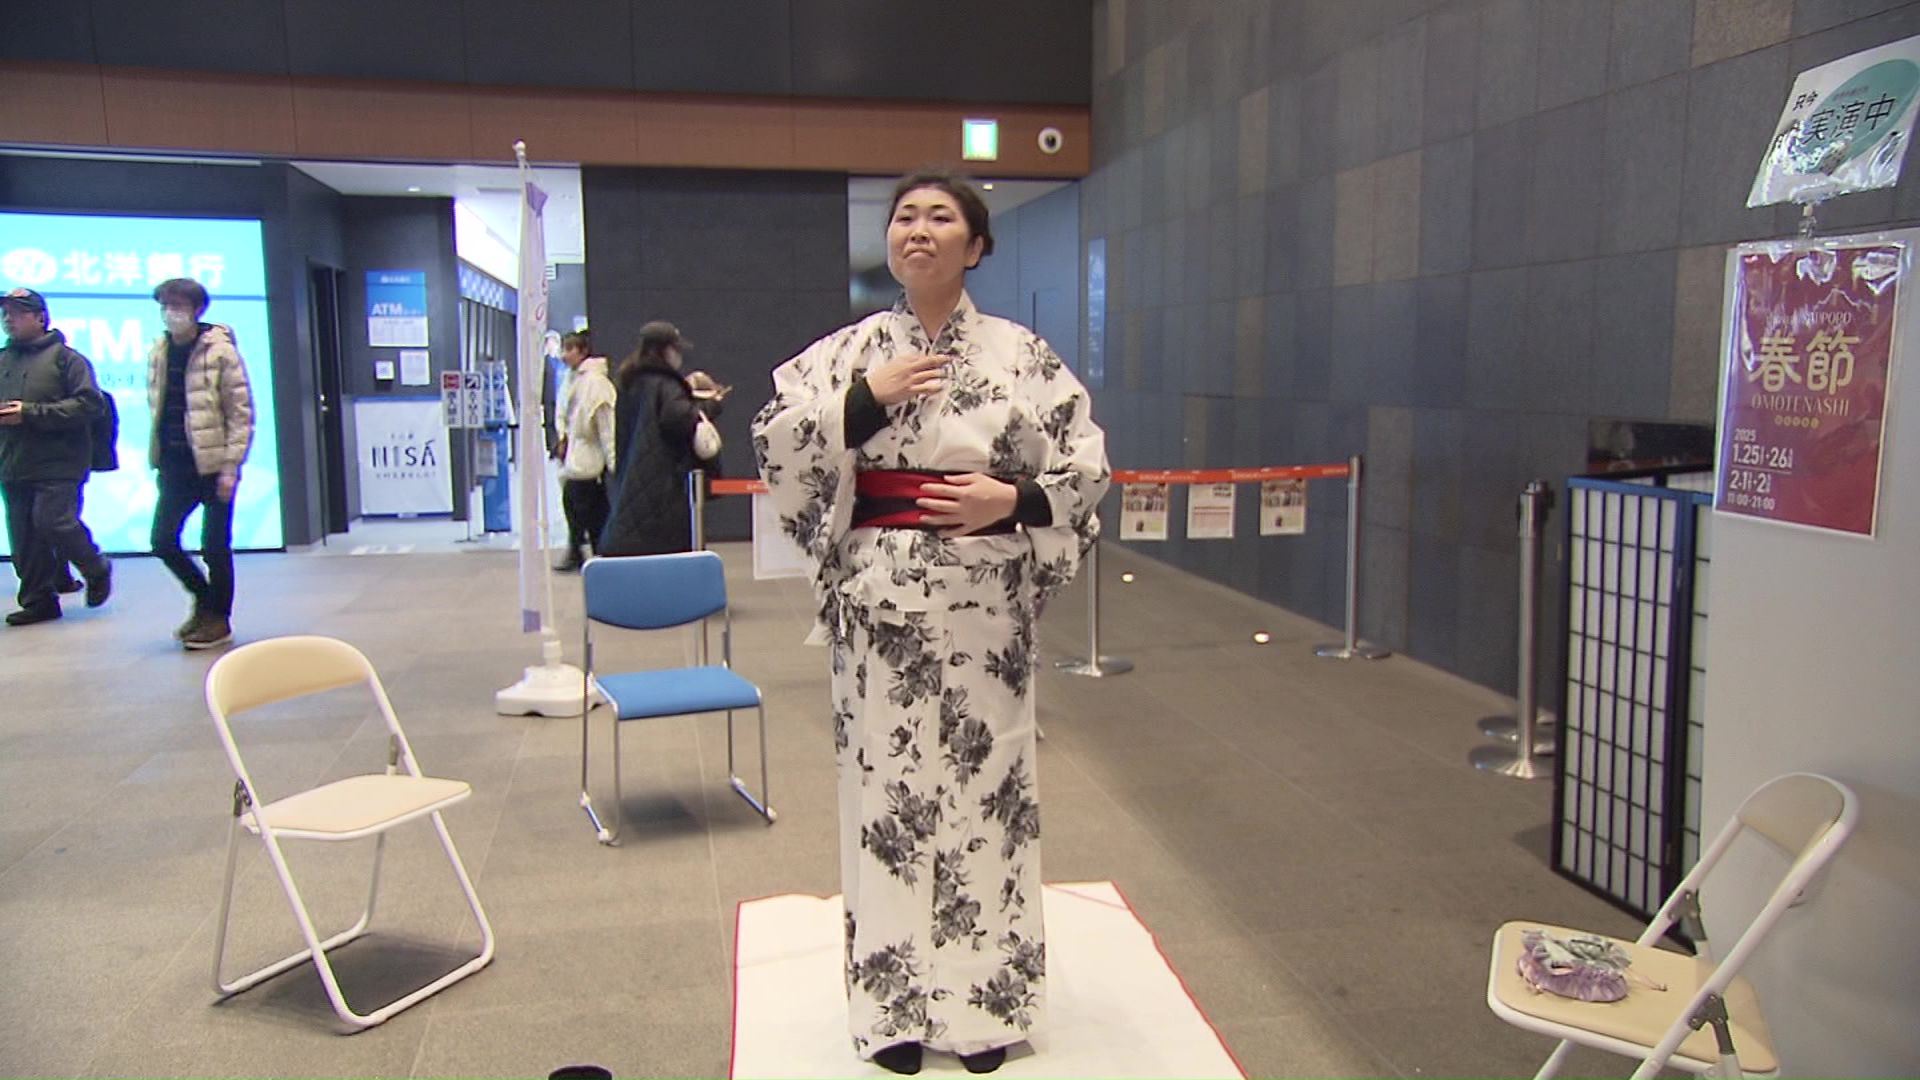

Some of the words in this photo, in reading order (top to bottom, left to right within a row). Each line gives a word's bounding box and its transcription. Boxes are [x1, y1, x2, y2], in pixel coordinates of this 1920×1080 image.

[1802, 92, 1897, 145] 実演中
[63, 250, 225, 289] 北洋銀行
[371, 302, 403, 316] ATM
[50, 318, 142, 362] TM
[1749, 328, 1860, 395] 春節
[1751, 394, 1850, 417] OMOTENASHI
[1734, 427, 1756, 442] 2025
